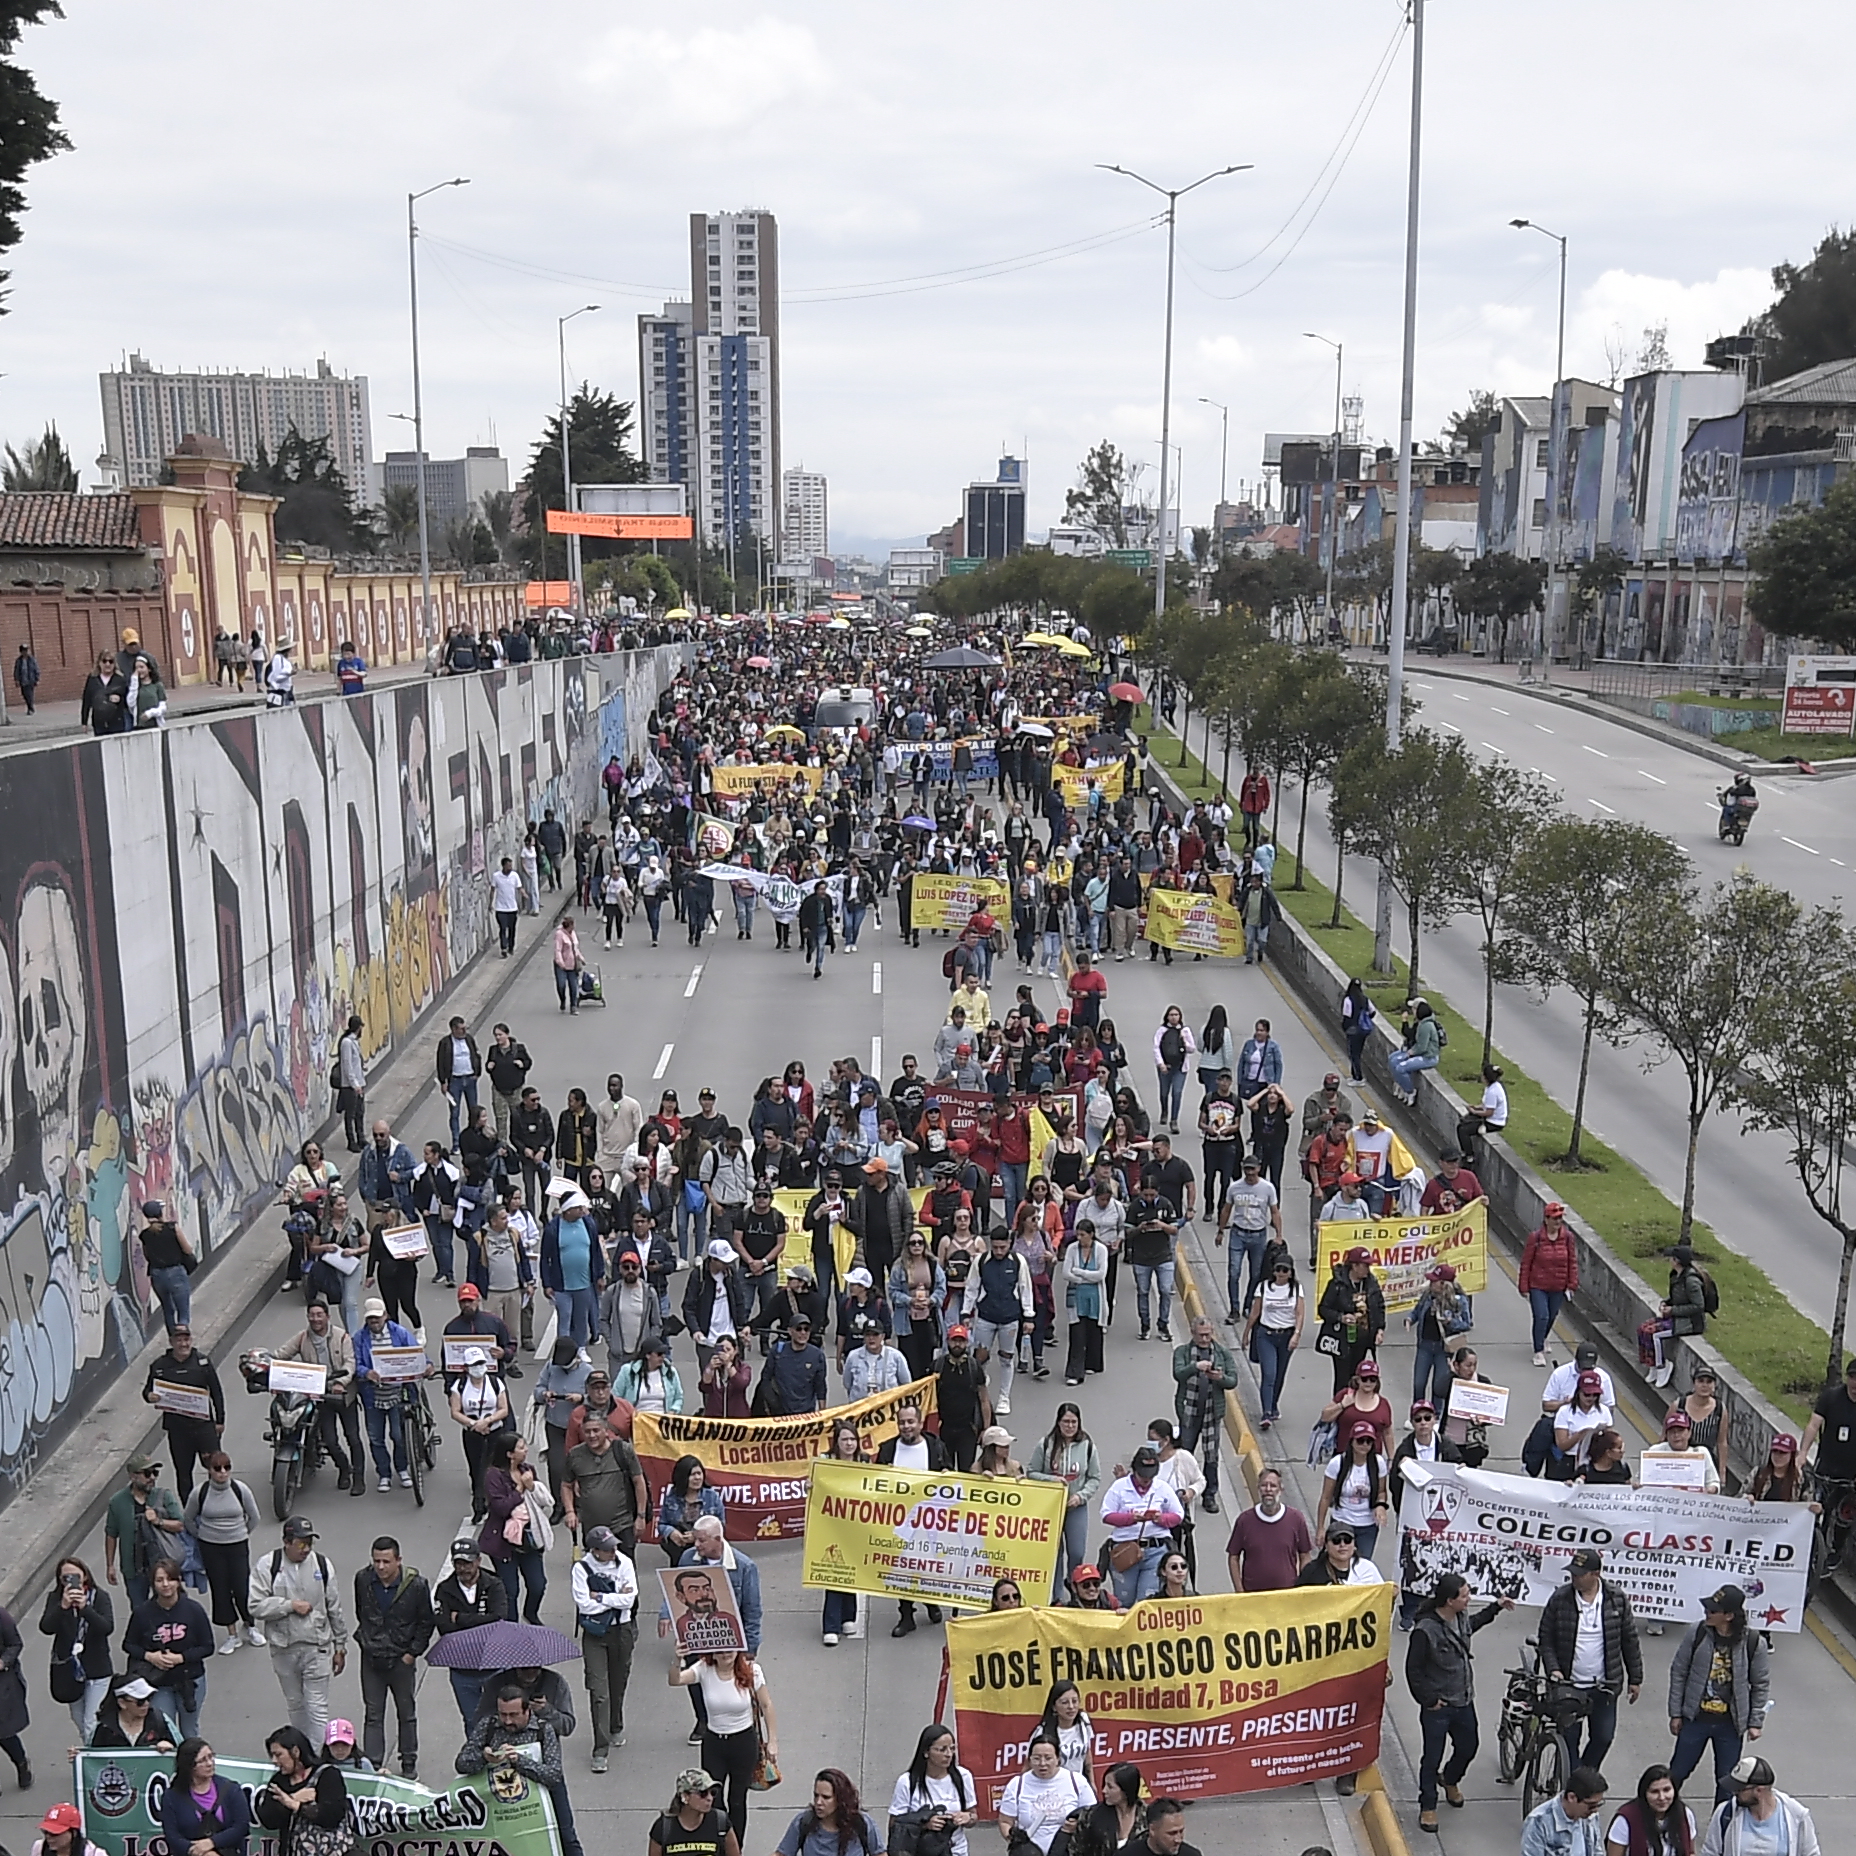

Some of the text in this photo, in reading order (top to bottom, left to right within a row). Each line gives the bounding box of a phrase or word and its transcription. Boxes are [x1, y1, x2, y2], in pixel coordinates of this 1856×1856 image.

[1787, 710, 1851, 718] AUTOLAVADO
[916, 889, 937, 900] LUIS
[939, 890, 967, 903] LOPEZ
[1354, 1228, 1393, 1240] I.E.D.
[1320, 1336, 1341, 1355] GRL
[658, 1417, 745, 1442] ORLANDO
[719, 1441, 807, 1466] Localidad
[862, 1477, 1022, 1506] I.E.D. COLEGIO
[1578, 1491, 1710, 1509] PORQUE LOS DERECHOS NO SE
[821, 1495, 1051, 1542] ANTONIO JOSE DE SUCRE
[1468, 1498, 1550, 1519] DOCENTES DEL
[1571, 1502, 1619, 1512] ARRANCAN
[1622, 1504, 1634, 1512] AL
[1635, 1506, 1664, 1516] CALOR
[1666, 1508, 1680, 1516] DE
[1682, 1509, 1694, 1517] LA
[1696, 1511, 1726, 1521] LUCHA
[869, 1534, 930, 1553] Localidad 16
[1477, 1512, 1795, 1563] COLEGIO CLASS I.E.D
[872, 1552, 1041, 1583] PRESENTE PRESENTE
[1610, 1550, 1620, 1560] Y
[1625, 1550, 1756, 1576] COMBATIENTES
[1618, 1565, 1678, 1579] EDUCACIÓN
[810, 1572, 855, 1585] Educación
[1655, 1597, 1684, 1608] DE LA
[687, 1617, 728, 1632] GALÁN
[1136, 1605, 1203, 1632] Colegio
[685, 1629, 734, 1641] CAZADOR
[687, 1638, 737, 1649] DE PROFES
[969, 1611, 1378, 1691] JOSÉ FRANCISCO SOCARRAS
[1195, 1685, 1214, 1711] 7,
[1220, 1678, 1279, 1705] Bosa
[1118, 1702, 1358, 1754] PRESENTE, PRESENTE!
[1251, 1758, 1261, 1768] Si
[1272, 1752, 1313, 1769] presente
[1315, 1751, 1325, 1760] es
[1327, 1749, 1336, 1759] de
[1267, 1755, 1351, 1776] el futuro es nuestro
